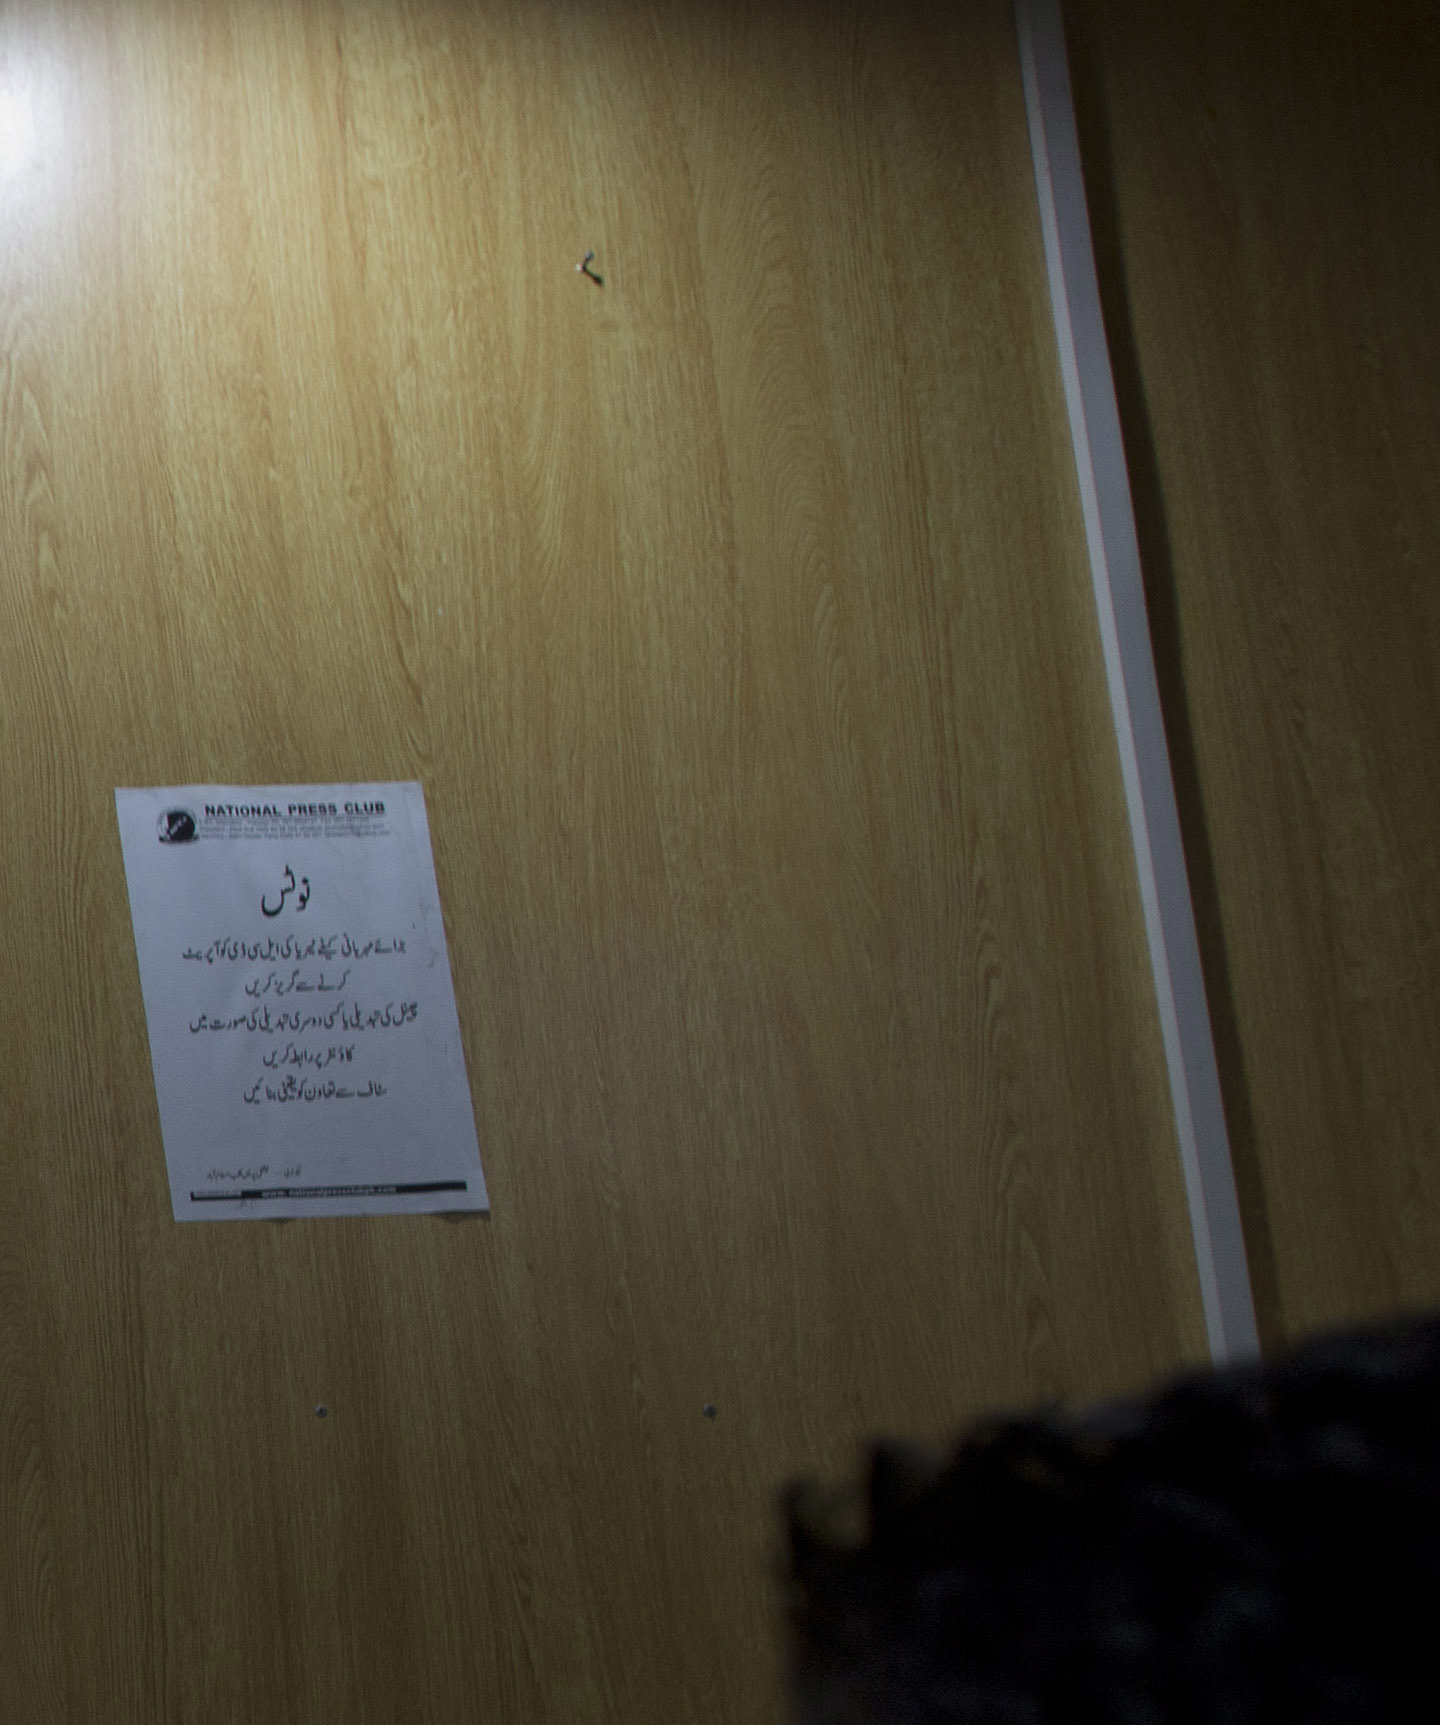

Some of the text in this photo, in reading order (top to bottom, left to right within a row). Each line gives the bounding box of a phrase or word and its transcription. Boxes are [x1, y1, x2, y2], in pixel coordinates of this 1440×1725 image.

[205, 801, 385, 818] NATIONAL PRESS CLUB
[261, 864, 310, 917] نوٹس
